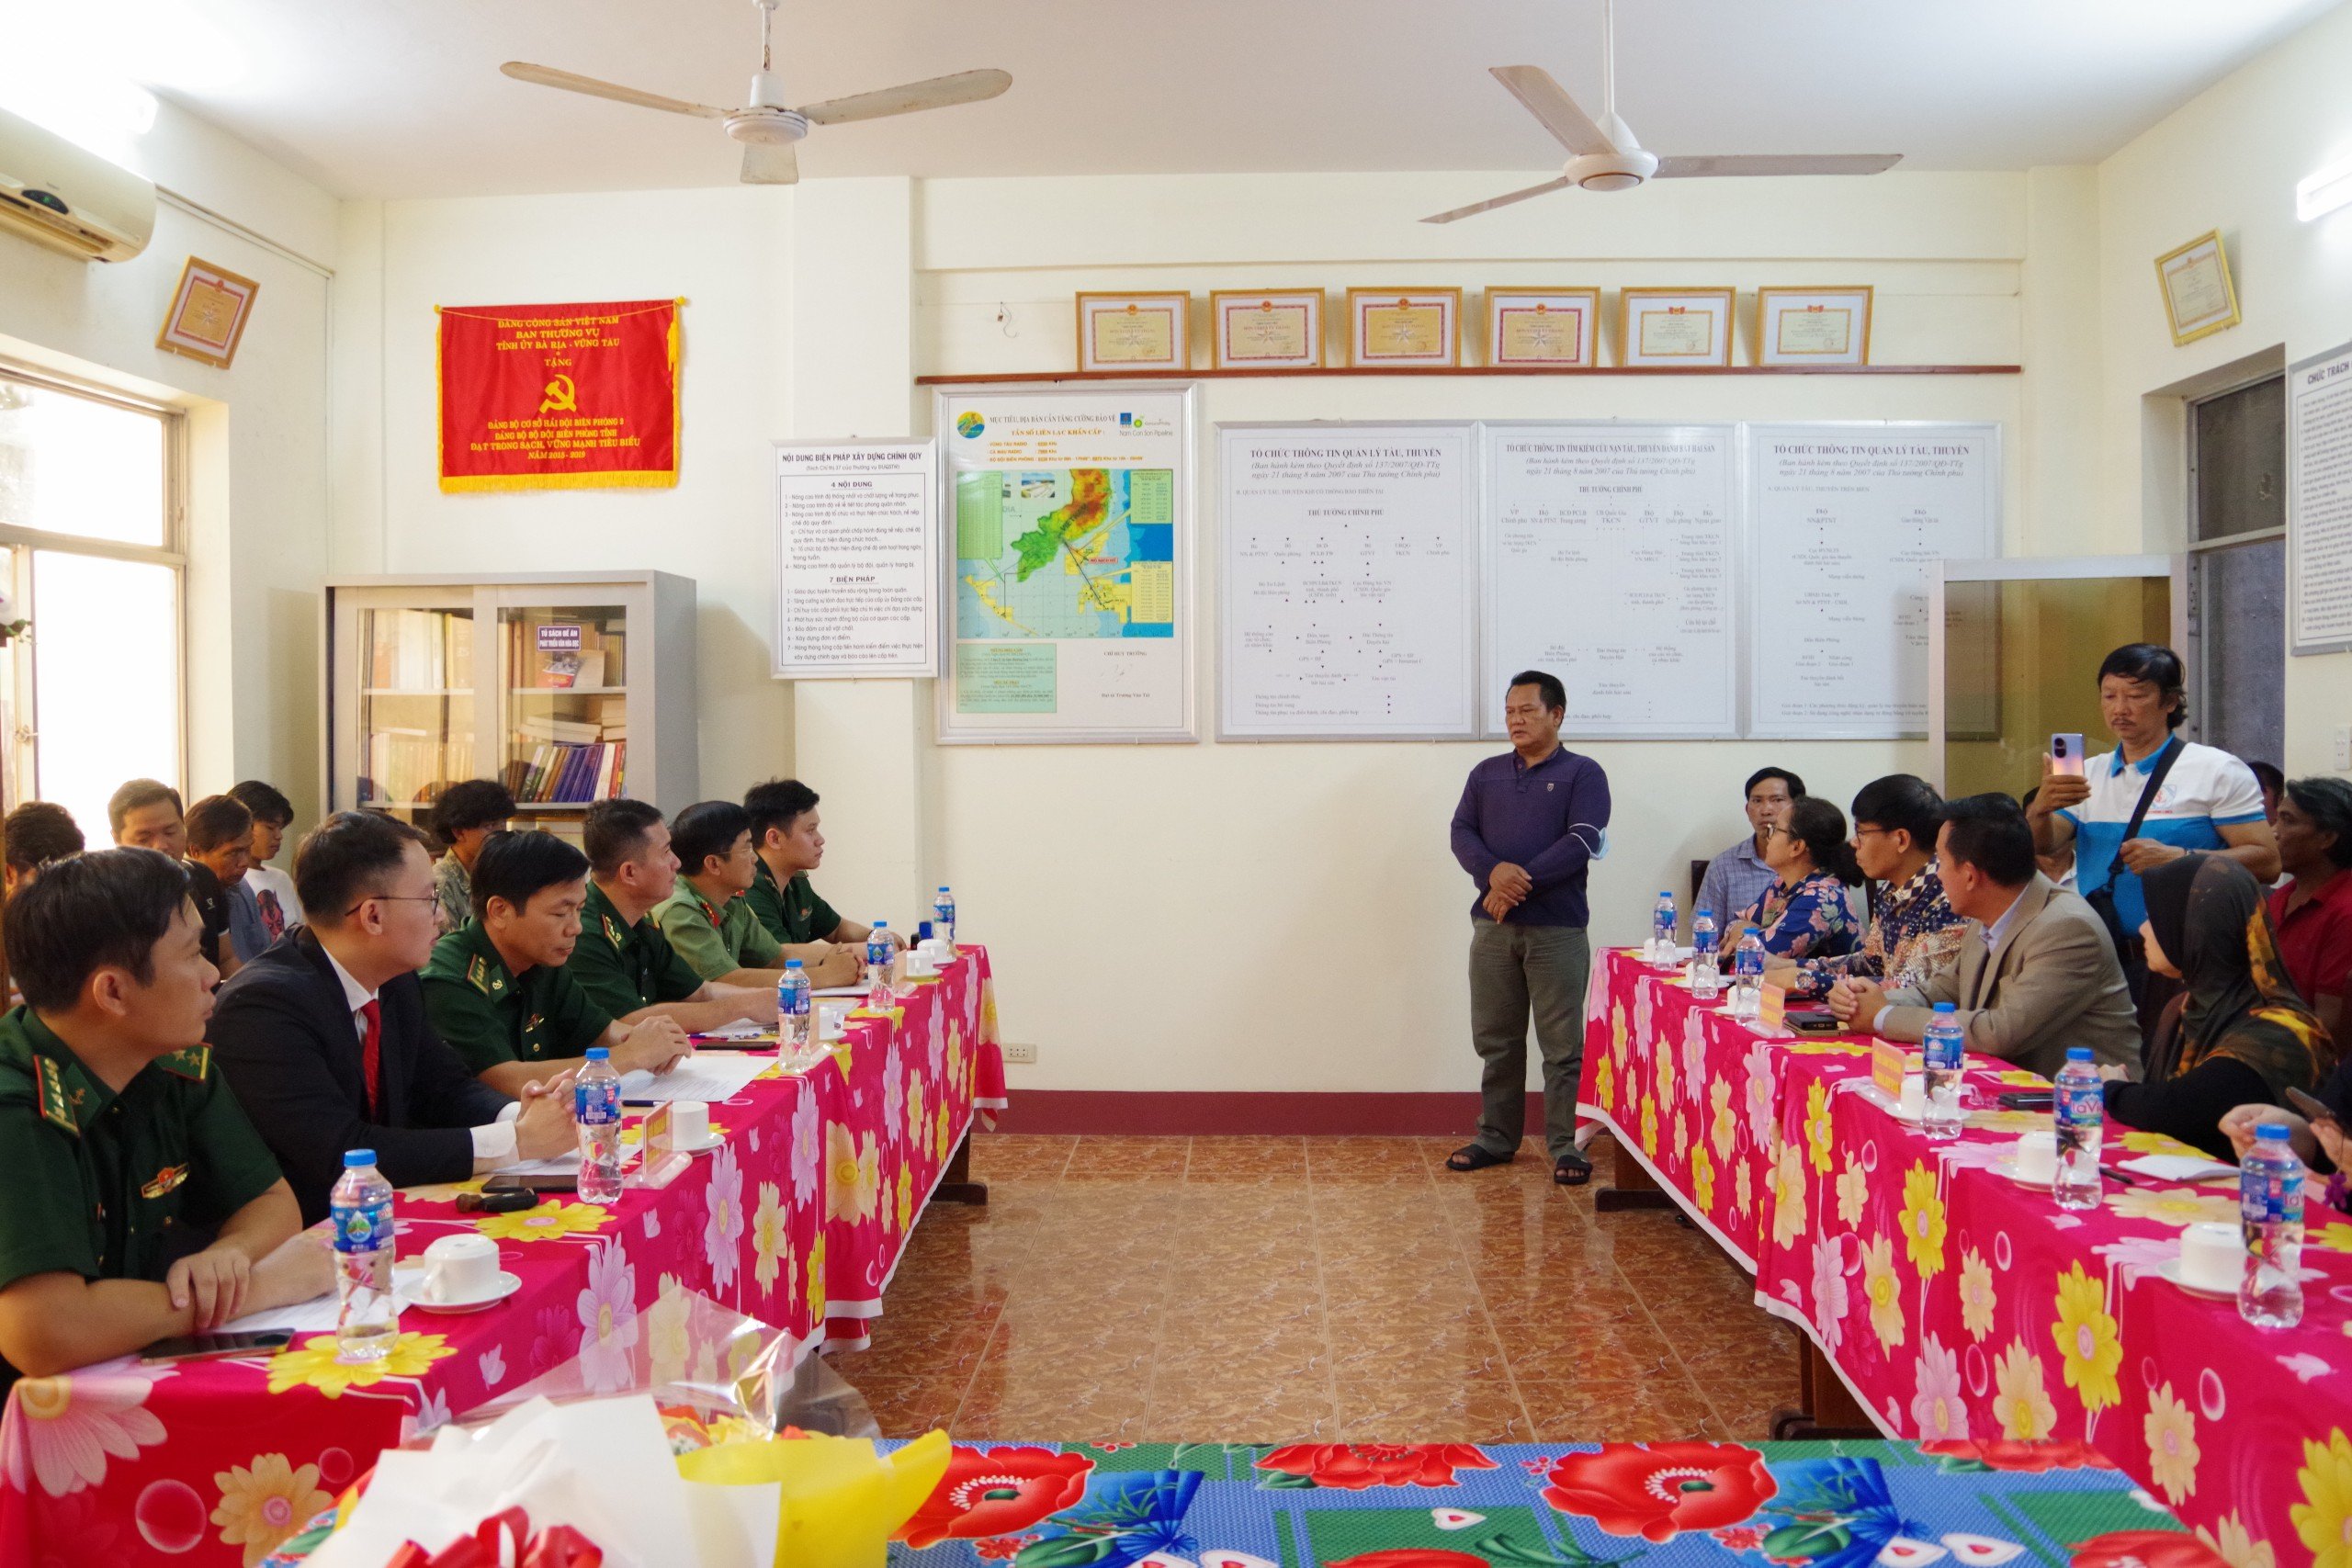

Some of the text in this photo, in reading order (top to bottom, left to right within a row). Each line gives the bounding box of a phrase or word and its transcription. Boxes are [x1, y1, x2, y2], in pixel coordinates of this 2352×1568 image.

[540, 329, 582, 338] THƯỜNG
[586, 329, 599, 337] VỤ
[536, 340, 548, 349] BÀ
[551, 341, 566, 350] RỊA
[574, 339, 599, 347] VŨNG
[602, 338, 619, 346] TÀU
[545, 358, 571, 367] TẶNG
[2308, 368, 2325, 385] CHỨC
[470, 442, 489, 452] ĐẠT
[491, 442, 518, 450] TRONG
[1294, 447, 1323, 457] THÔNG
[1327, 449, 1340, 457] TIN
[1851, 446, 1866, 455] TIN
[783, 454, 793, 462] NỘI
[796, 454, 813, 462] DUNG
[816, 453, 831, 462] BIỆN
[833, 452, 850, 461] PHÁP
[853, 452, 865, 460] XÂY
[867, 453, 885, 461] DỰNG
[909, 452, 922, 460] QUY
